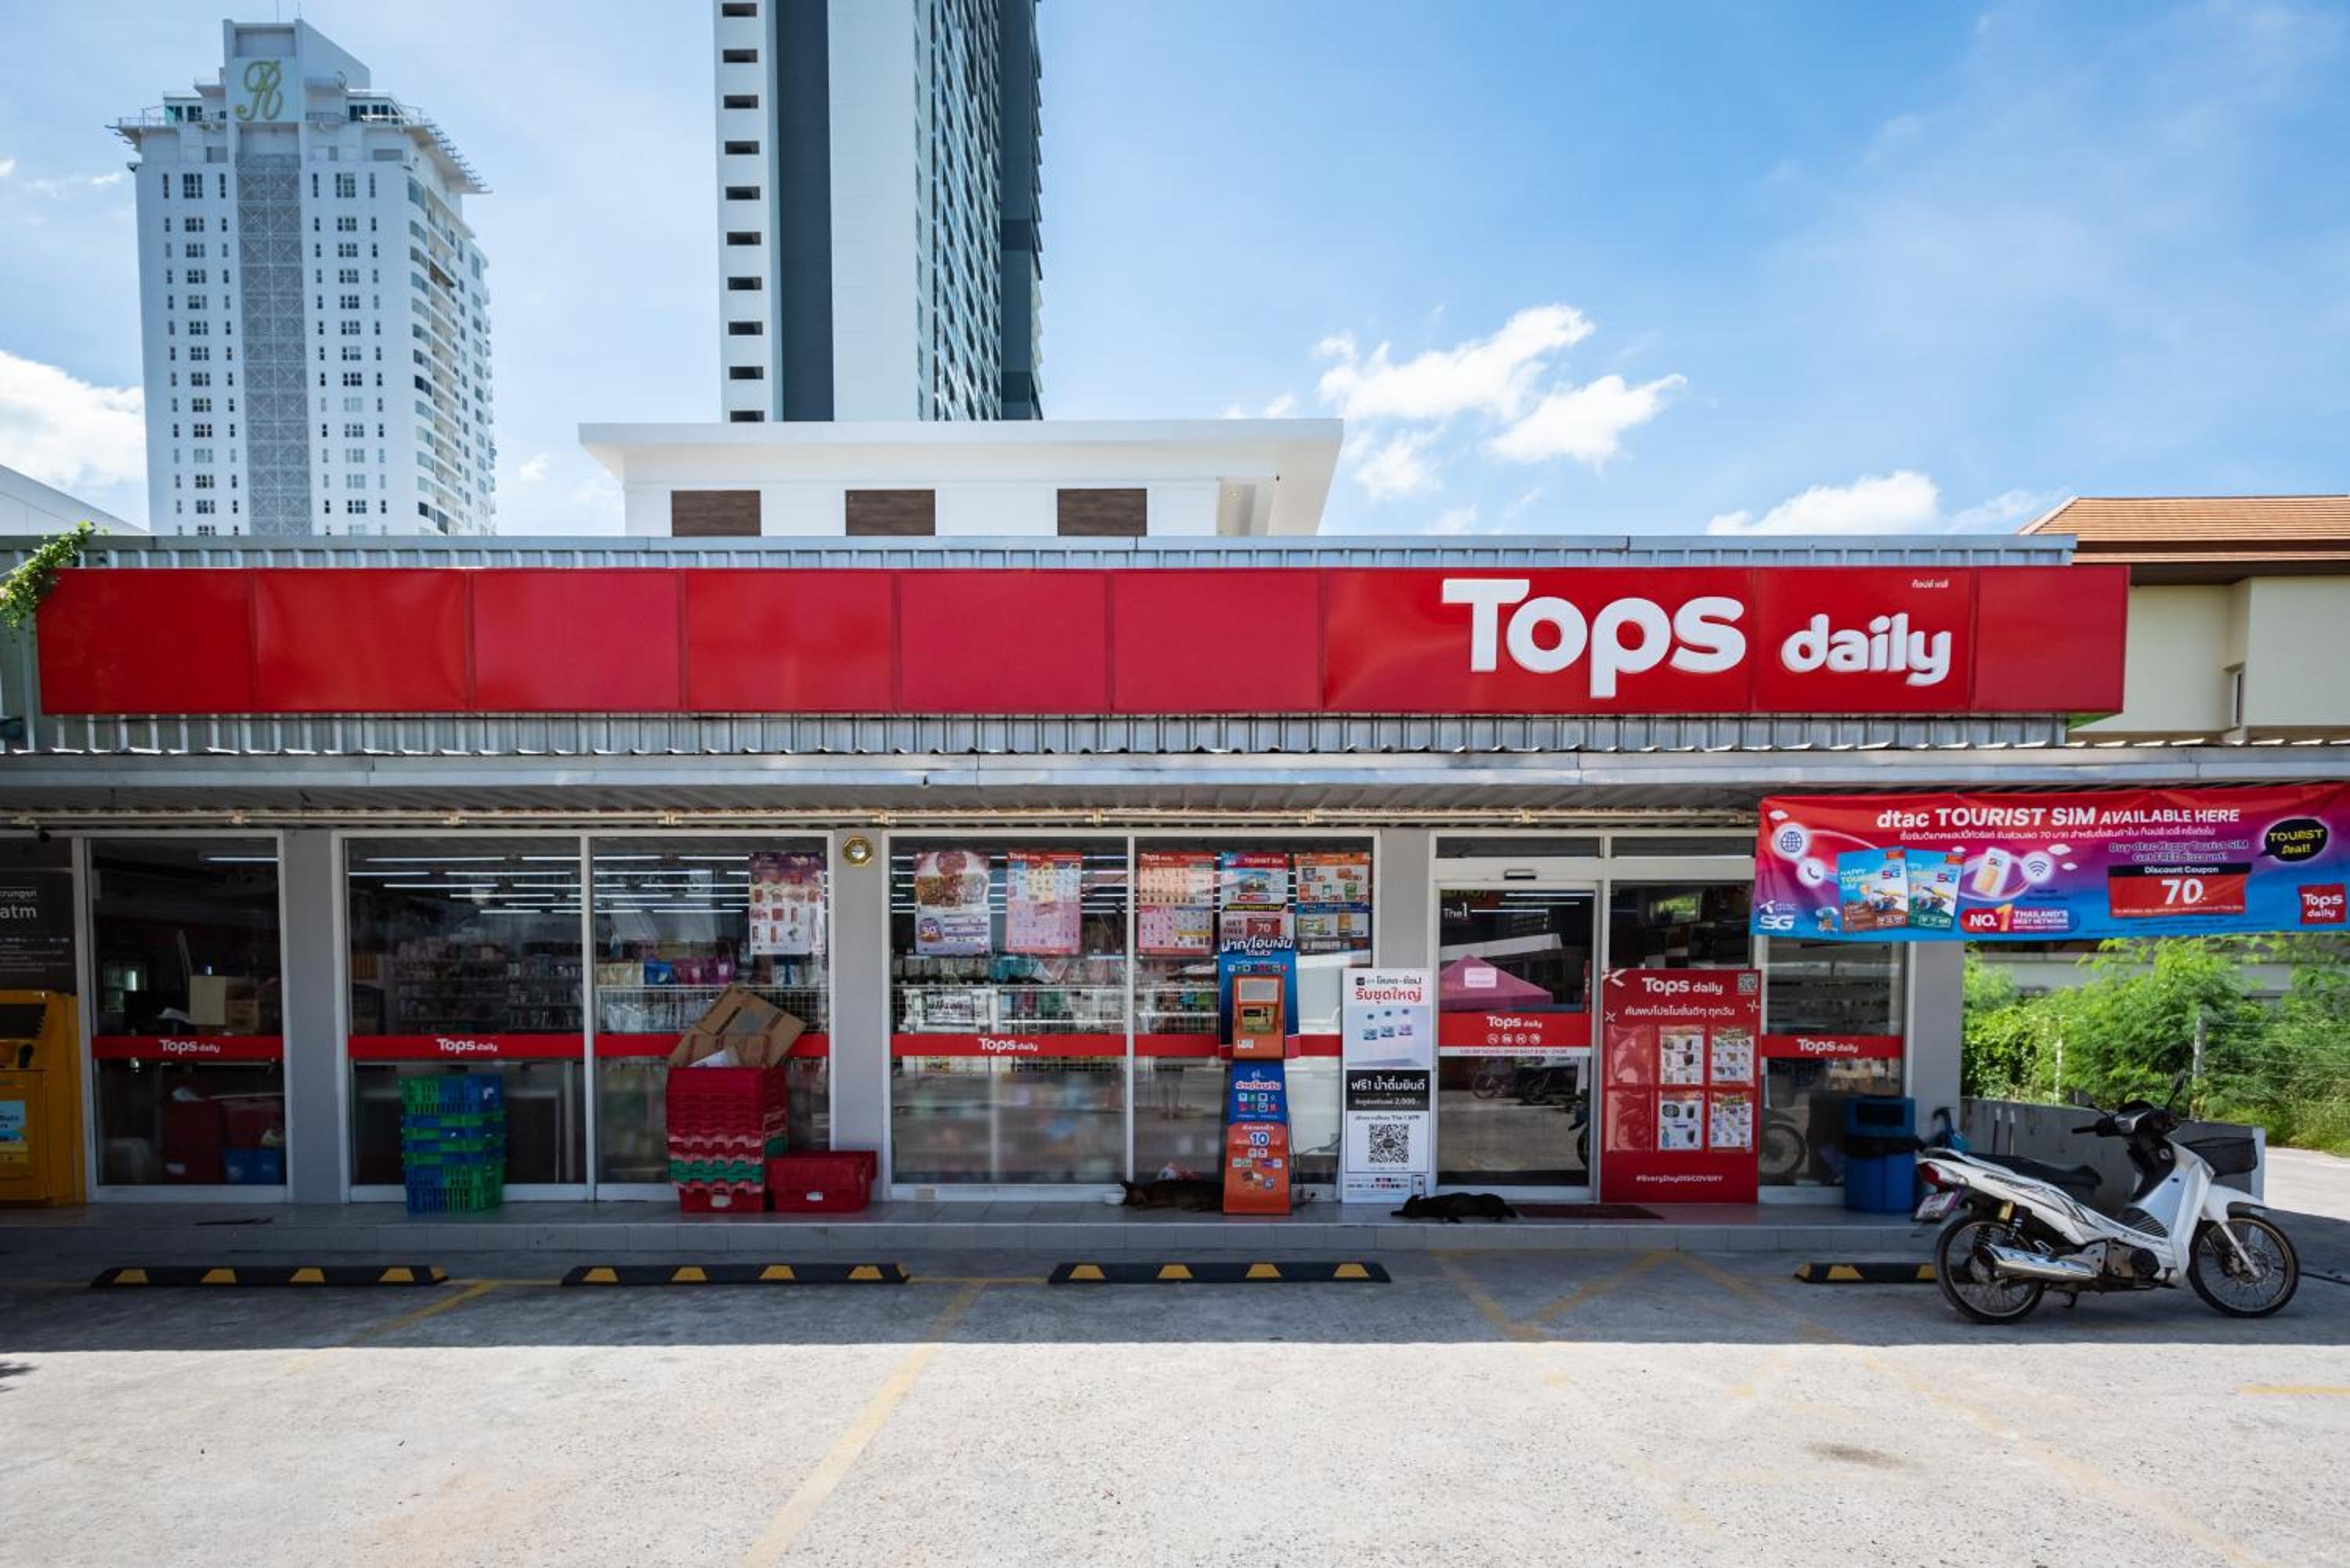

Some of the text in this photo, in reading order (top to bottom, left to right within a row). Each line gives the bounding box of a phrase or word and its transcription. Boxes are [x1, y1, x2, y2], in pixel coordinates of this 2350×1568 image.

[1441, 578, 1952, 699] Tops daily
[1876, 807, 2240, 828] dtac TOURIST SIM AVAILABLE HERE
[2040, 830, 2052, 839] 70
[2185, 865, 2219, 875] Coupon
[2301, 894, 2344, 908] Tops
[0, 904, 38, 919] atm
[1969, 913, 1997, 927] NO.
[1994, 903, 2013, 932] 1
[2307, 909, 2337, 919] daily
[1256, 923, 1271, 933] 70
[1641, 977, 1723, 996] Tops daily
[1356, 987, 1422, 1004] รับชุดใหญ่
[1485, 1016, 1522, 1030] Tops
[158, 1039, 220, 1055] Tops daily
[435, 1038, 498, 1055] Tops daily
[978, 1037, 1038, 1053] Tops daily
[1796, 1038, 1859, 1055] Tops daily
[1251, 1133, 1269, 1146] 10
